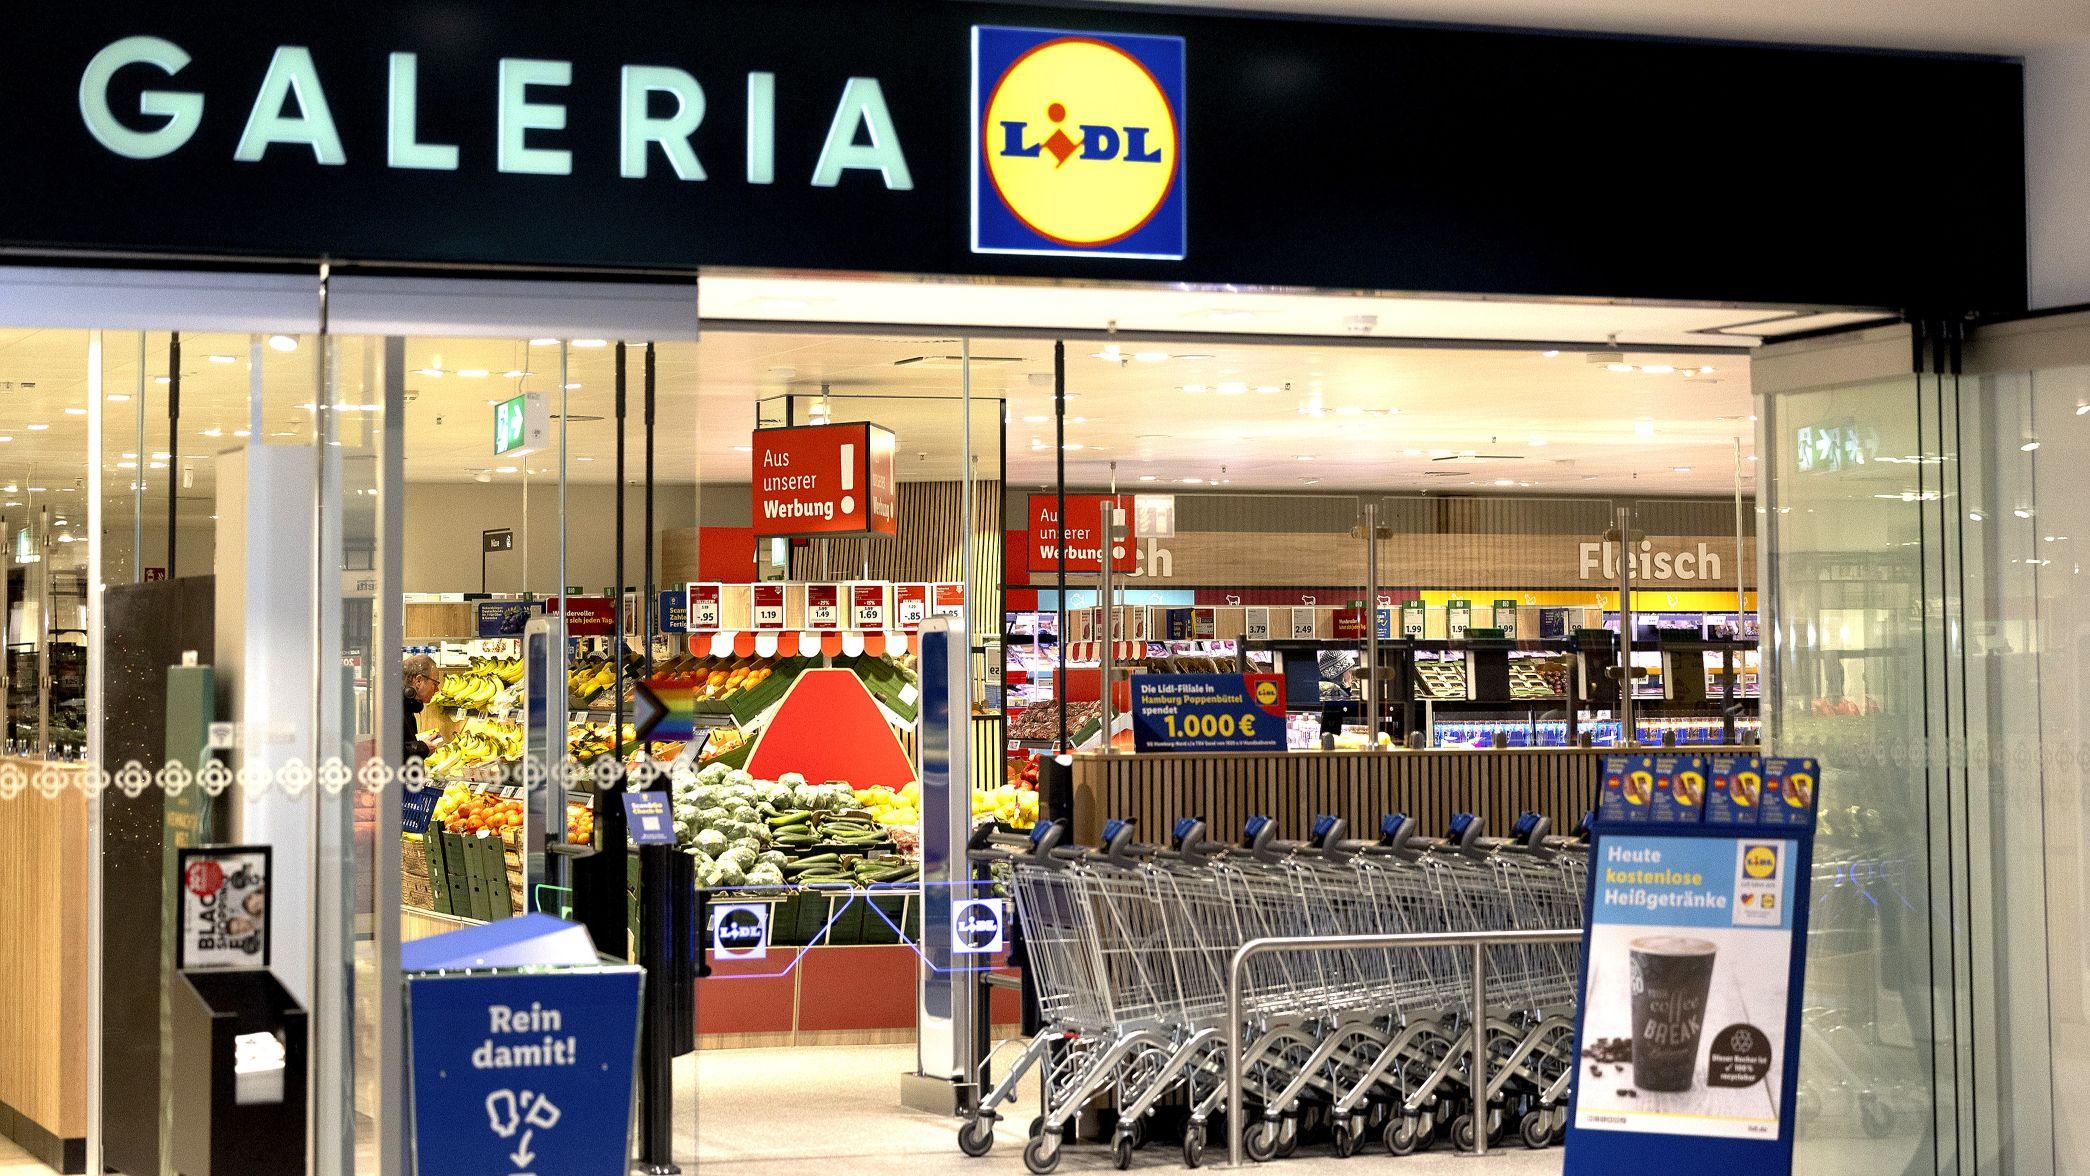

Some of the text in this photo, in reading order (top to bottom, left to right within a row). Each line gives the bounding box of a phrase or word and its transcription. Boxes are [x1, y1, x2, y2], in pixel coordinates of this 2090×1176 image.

[79, 35, 914, 191] GALERIA
[763, 449, 790, 467] Aus
[763, 475, 816, 491] unserer
[763, 498, 834, 520] Werbung
[1040, 508, 1060, 522] Au
[1040, 528, 1090, 540] unerer
[1579, 541, 1721, 580] Fleisch
[697, 612, 714, 621] -.95
[761, 611, 777, 619] 1.19
[816, 610, 830, 618] 1.49
[859, 610, 878, 619] 1.69
[904, 612, 921, 620] -.85
[1250, 625, 1266, 633] 3.79
[1295, 625, 1312, 633] 2.49
[1406, 625, 1422, 633] 1.99
[1141, 683, 1214, 694] Die Lidl-Filiale in
[1141, 694, 1243, 706] Hamburg Poppenbüttel
[1142, 705, 1178, 716] spendet
[1164, 713, 1256, 738] 1.000 €
[1608, 845, 1661, 863] Heute
[1605, 867, 1702, 886] kostenlose
[1604, 888, 1727, 911] Heißgetränke
[199, 891, 216, 950] BLAC
[488, 1001, 562, 1033] Rein
[1643, 1014, 1700, 1046] BREAK
[471, 1035, 577, 1069] damit!
